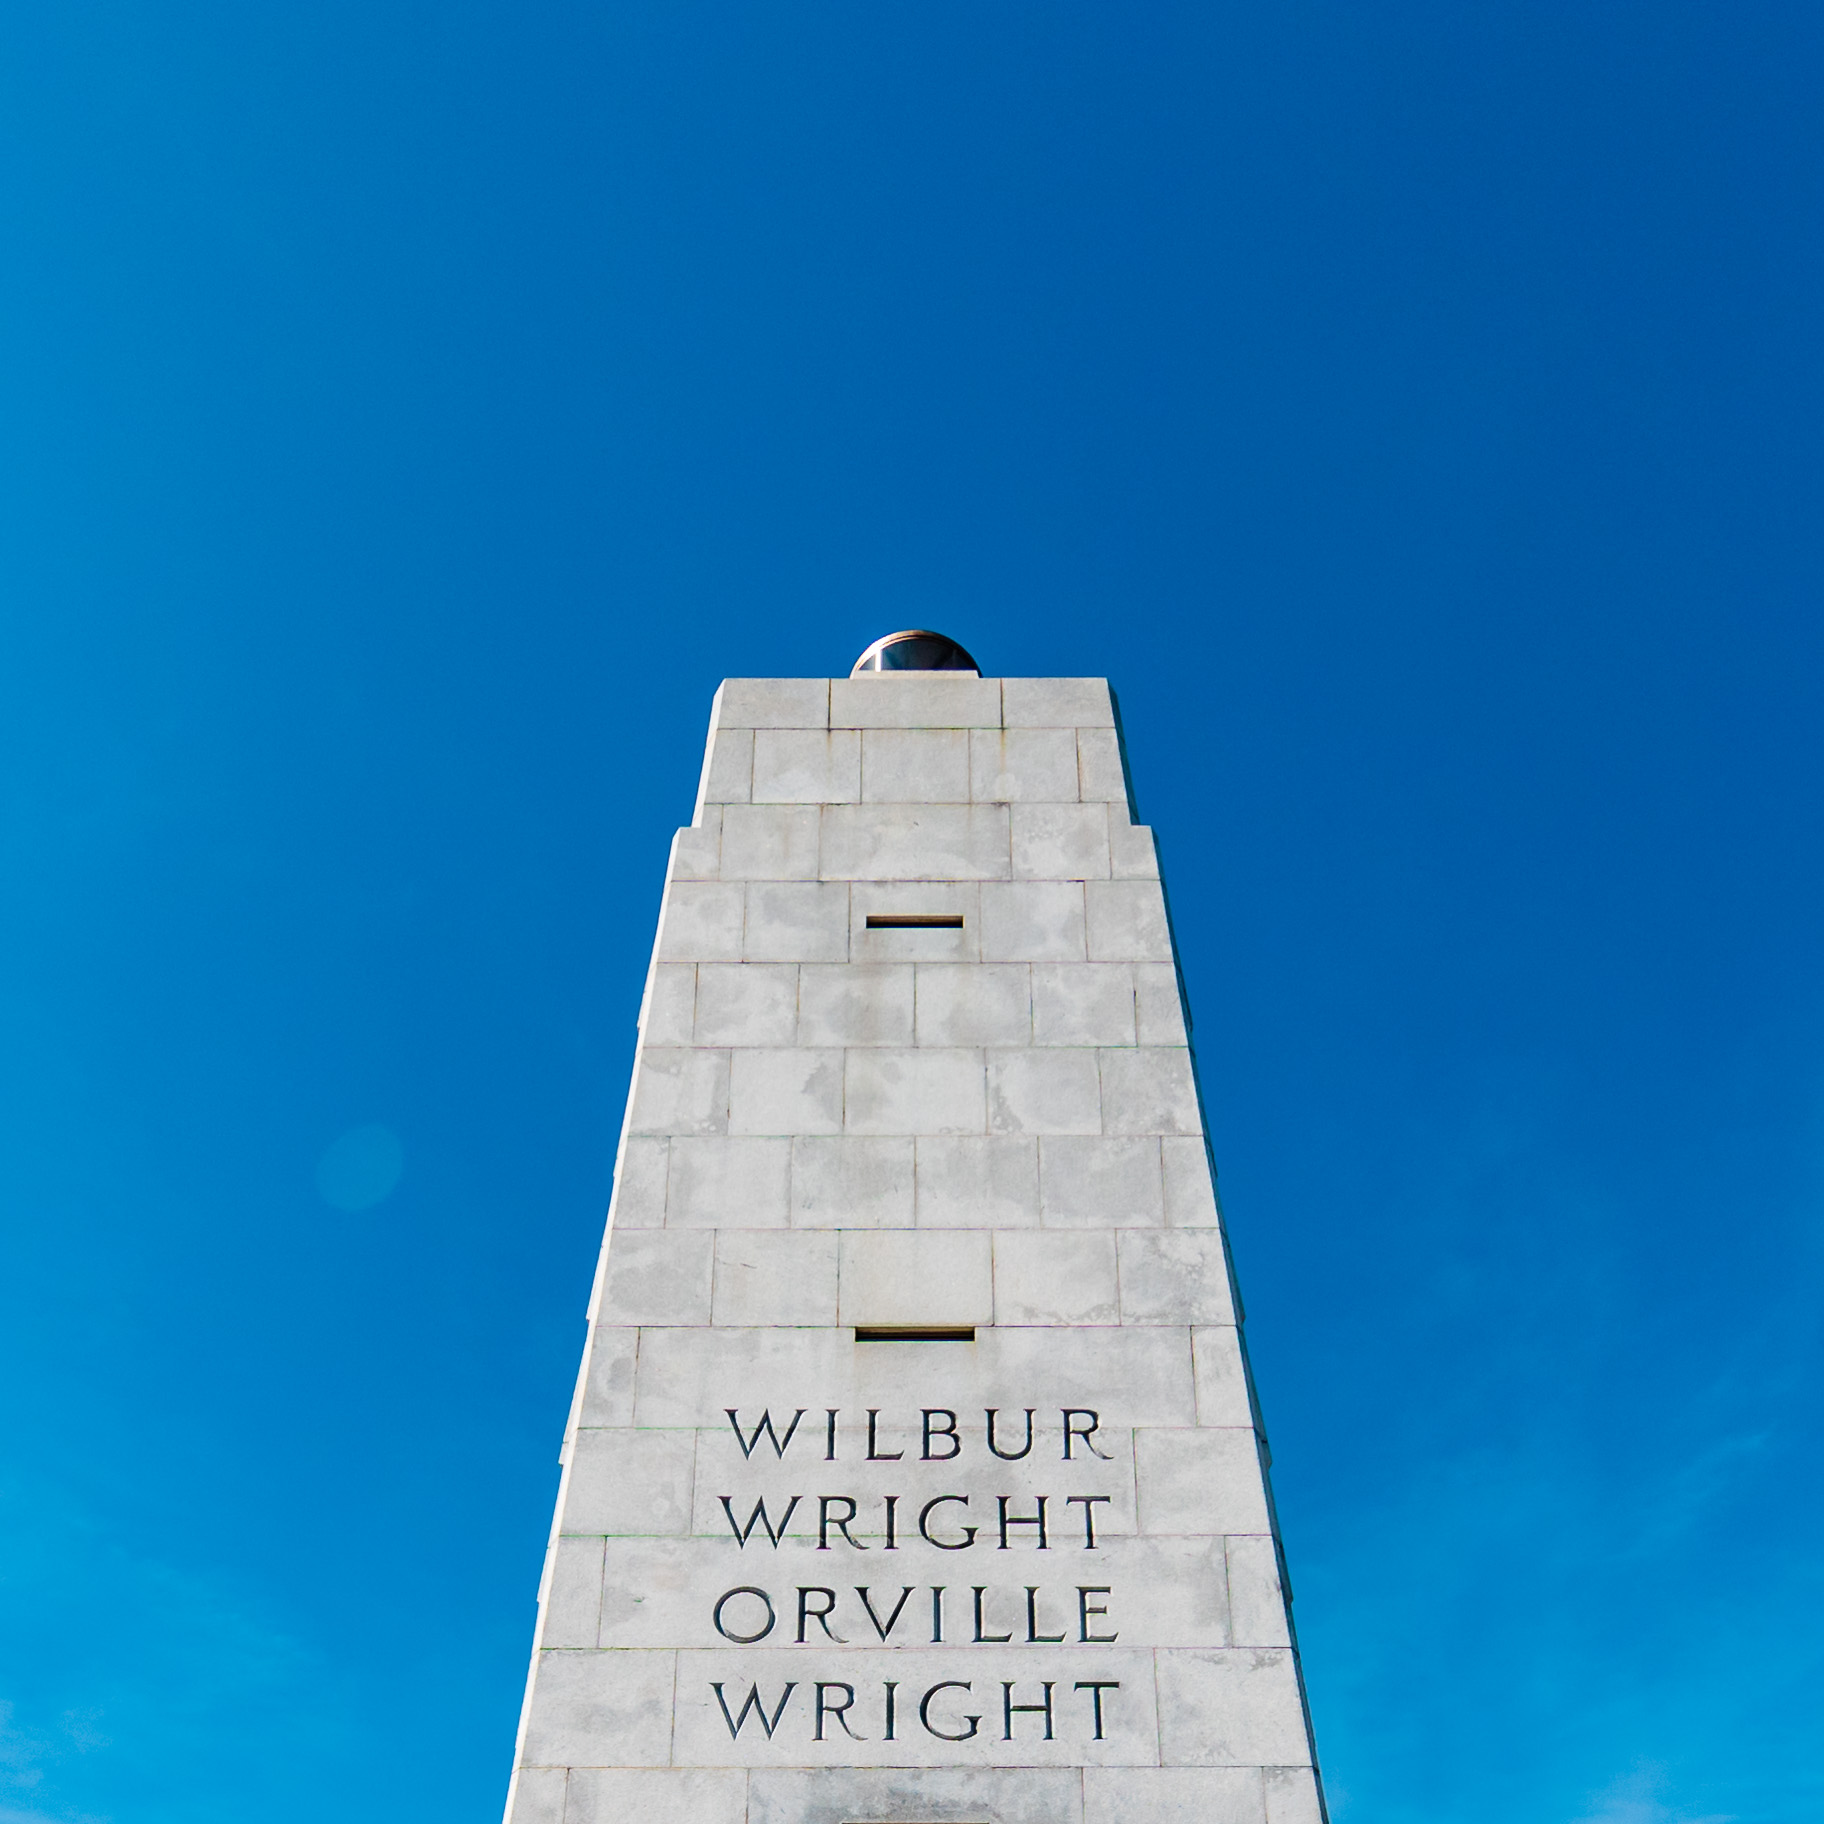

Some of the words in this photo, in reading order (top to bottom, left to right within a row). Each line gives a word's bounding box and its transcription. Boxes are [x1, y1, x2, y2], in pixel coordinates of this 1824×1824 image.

[724, 1408, 1114, 1461] WILBUR
[718, 1495, 1112, 1550] WRIGHT
[712, 1586, 1119, 1643] ORVILLE
[709, 1680, 1120, 1741] WRIGHT
